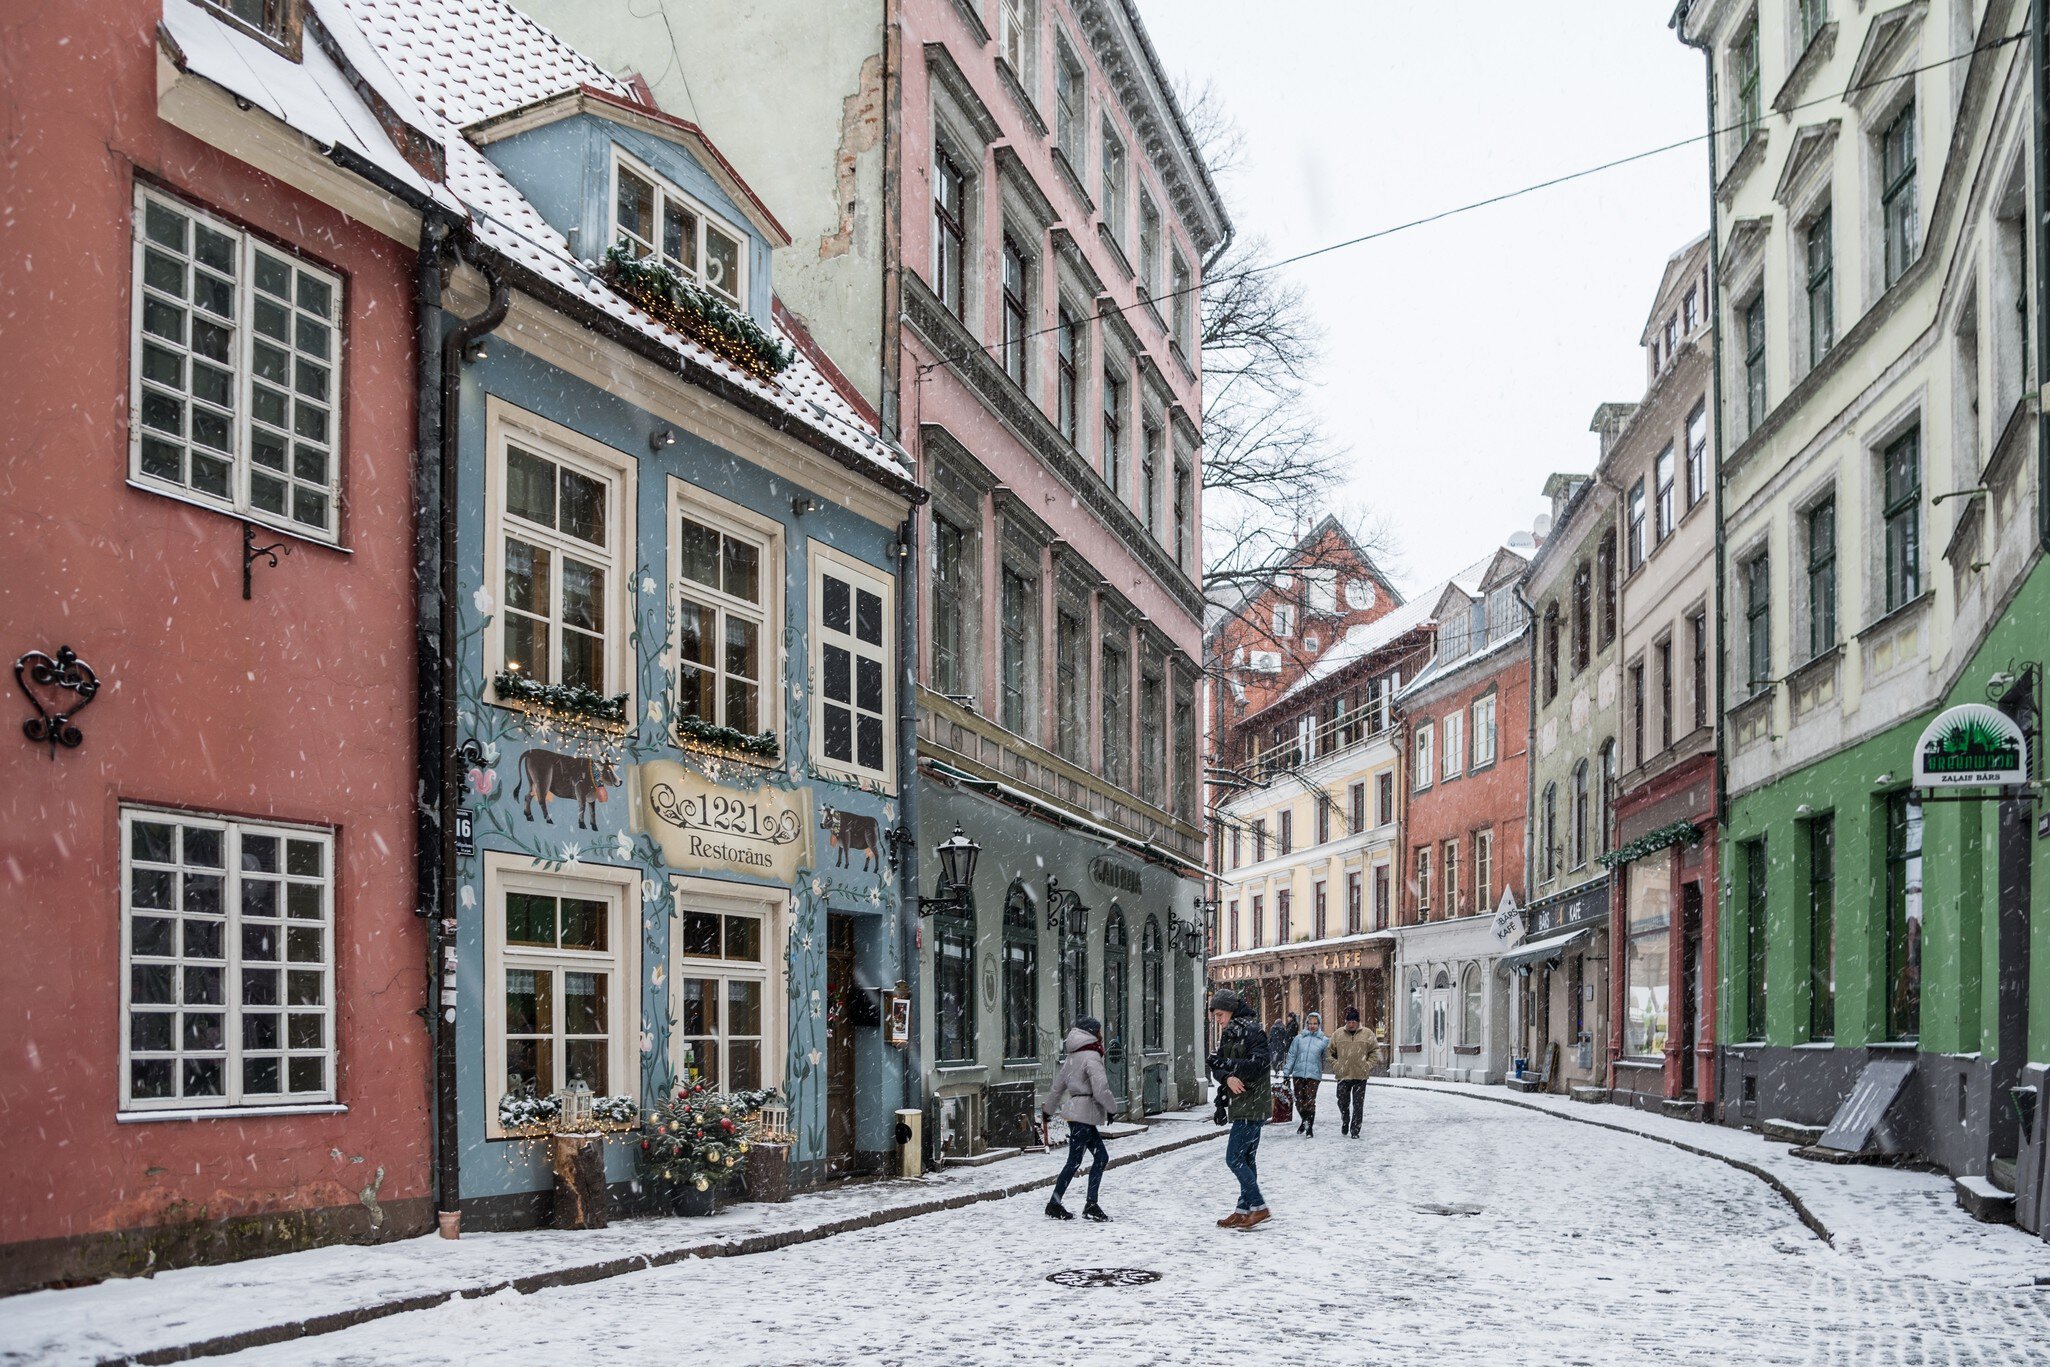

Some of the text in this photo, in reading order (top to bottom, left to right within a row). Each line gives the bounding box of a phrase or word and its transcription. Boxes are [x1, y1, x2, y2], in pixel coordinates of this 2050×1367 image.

[456, 818, 471, 838] 16
[697, 793, 762, 836] 1221
[688, 834, 773, 867] Restorāns
[1496, 908, 1519, 926] BĀRS
[1221, 950, 1362, 980] CUBA CAFE
